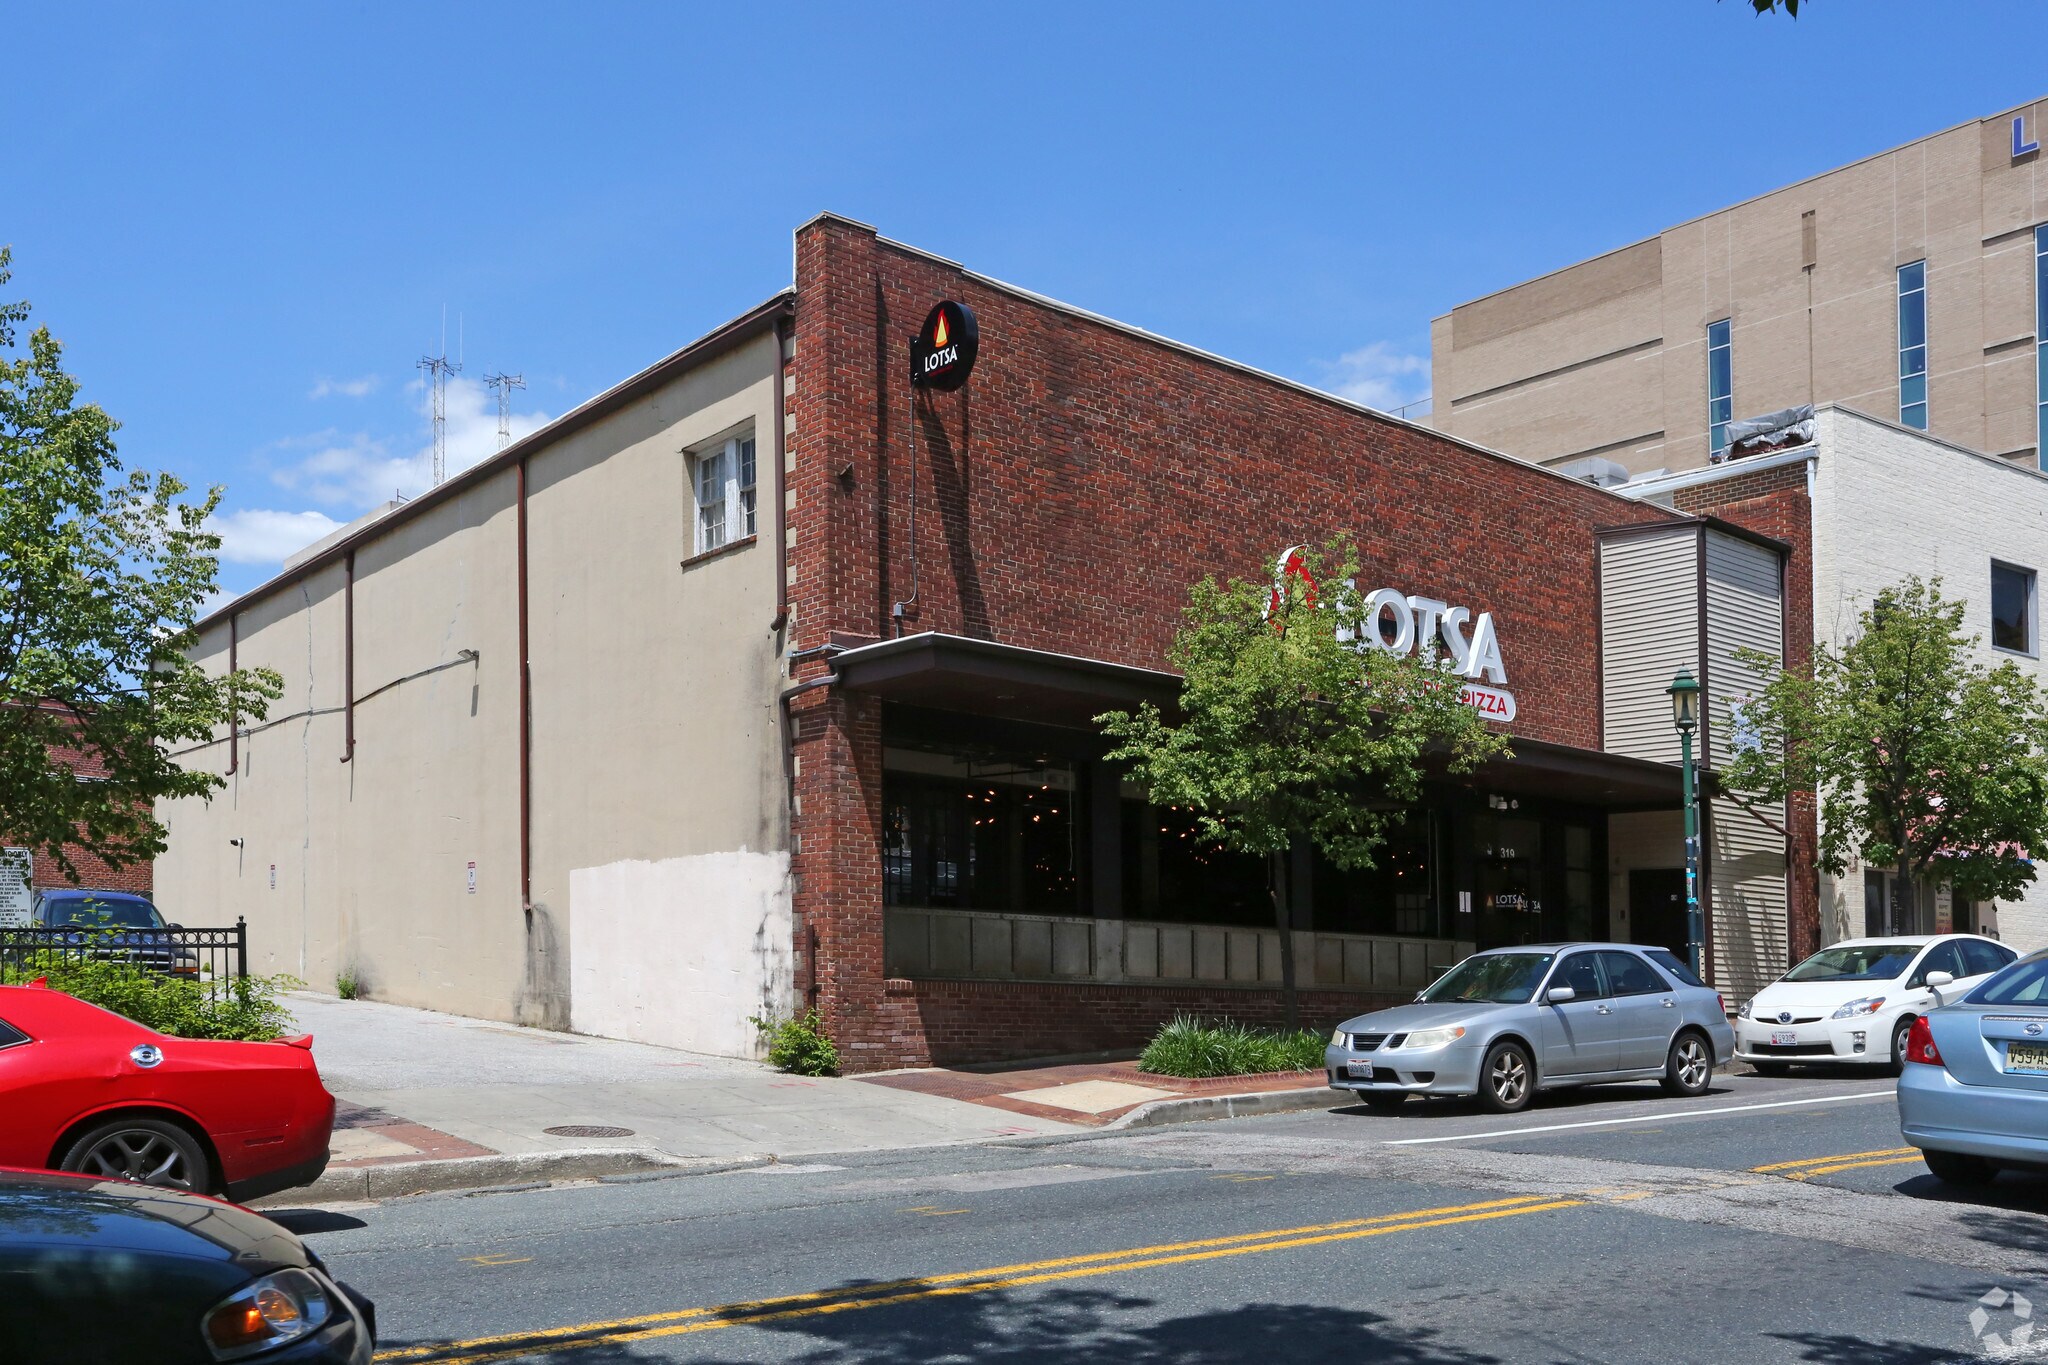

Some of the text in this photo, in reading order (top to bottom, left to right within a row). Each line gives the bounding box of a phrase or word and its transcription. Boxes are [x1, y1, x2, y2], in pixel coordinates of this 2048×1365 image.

[2012, 116, 2039, 157] L
[925, 345, 957, 372] LOTSA
[1461, 689, 1507, 715] PIZZA
[1501, 848, 1515, 858] 319
[1496, 895, 1524, 904] LOTSA
[2011, 1049, 2034, 1064] V59
